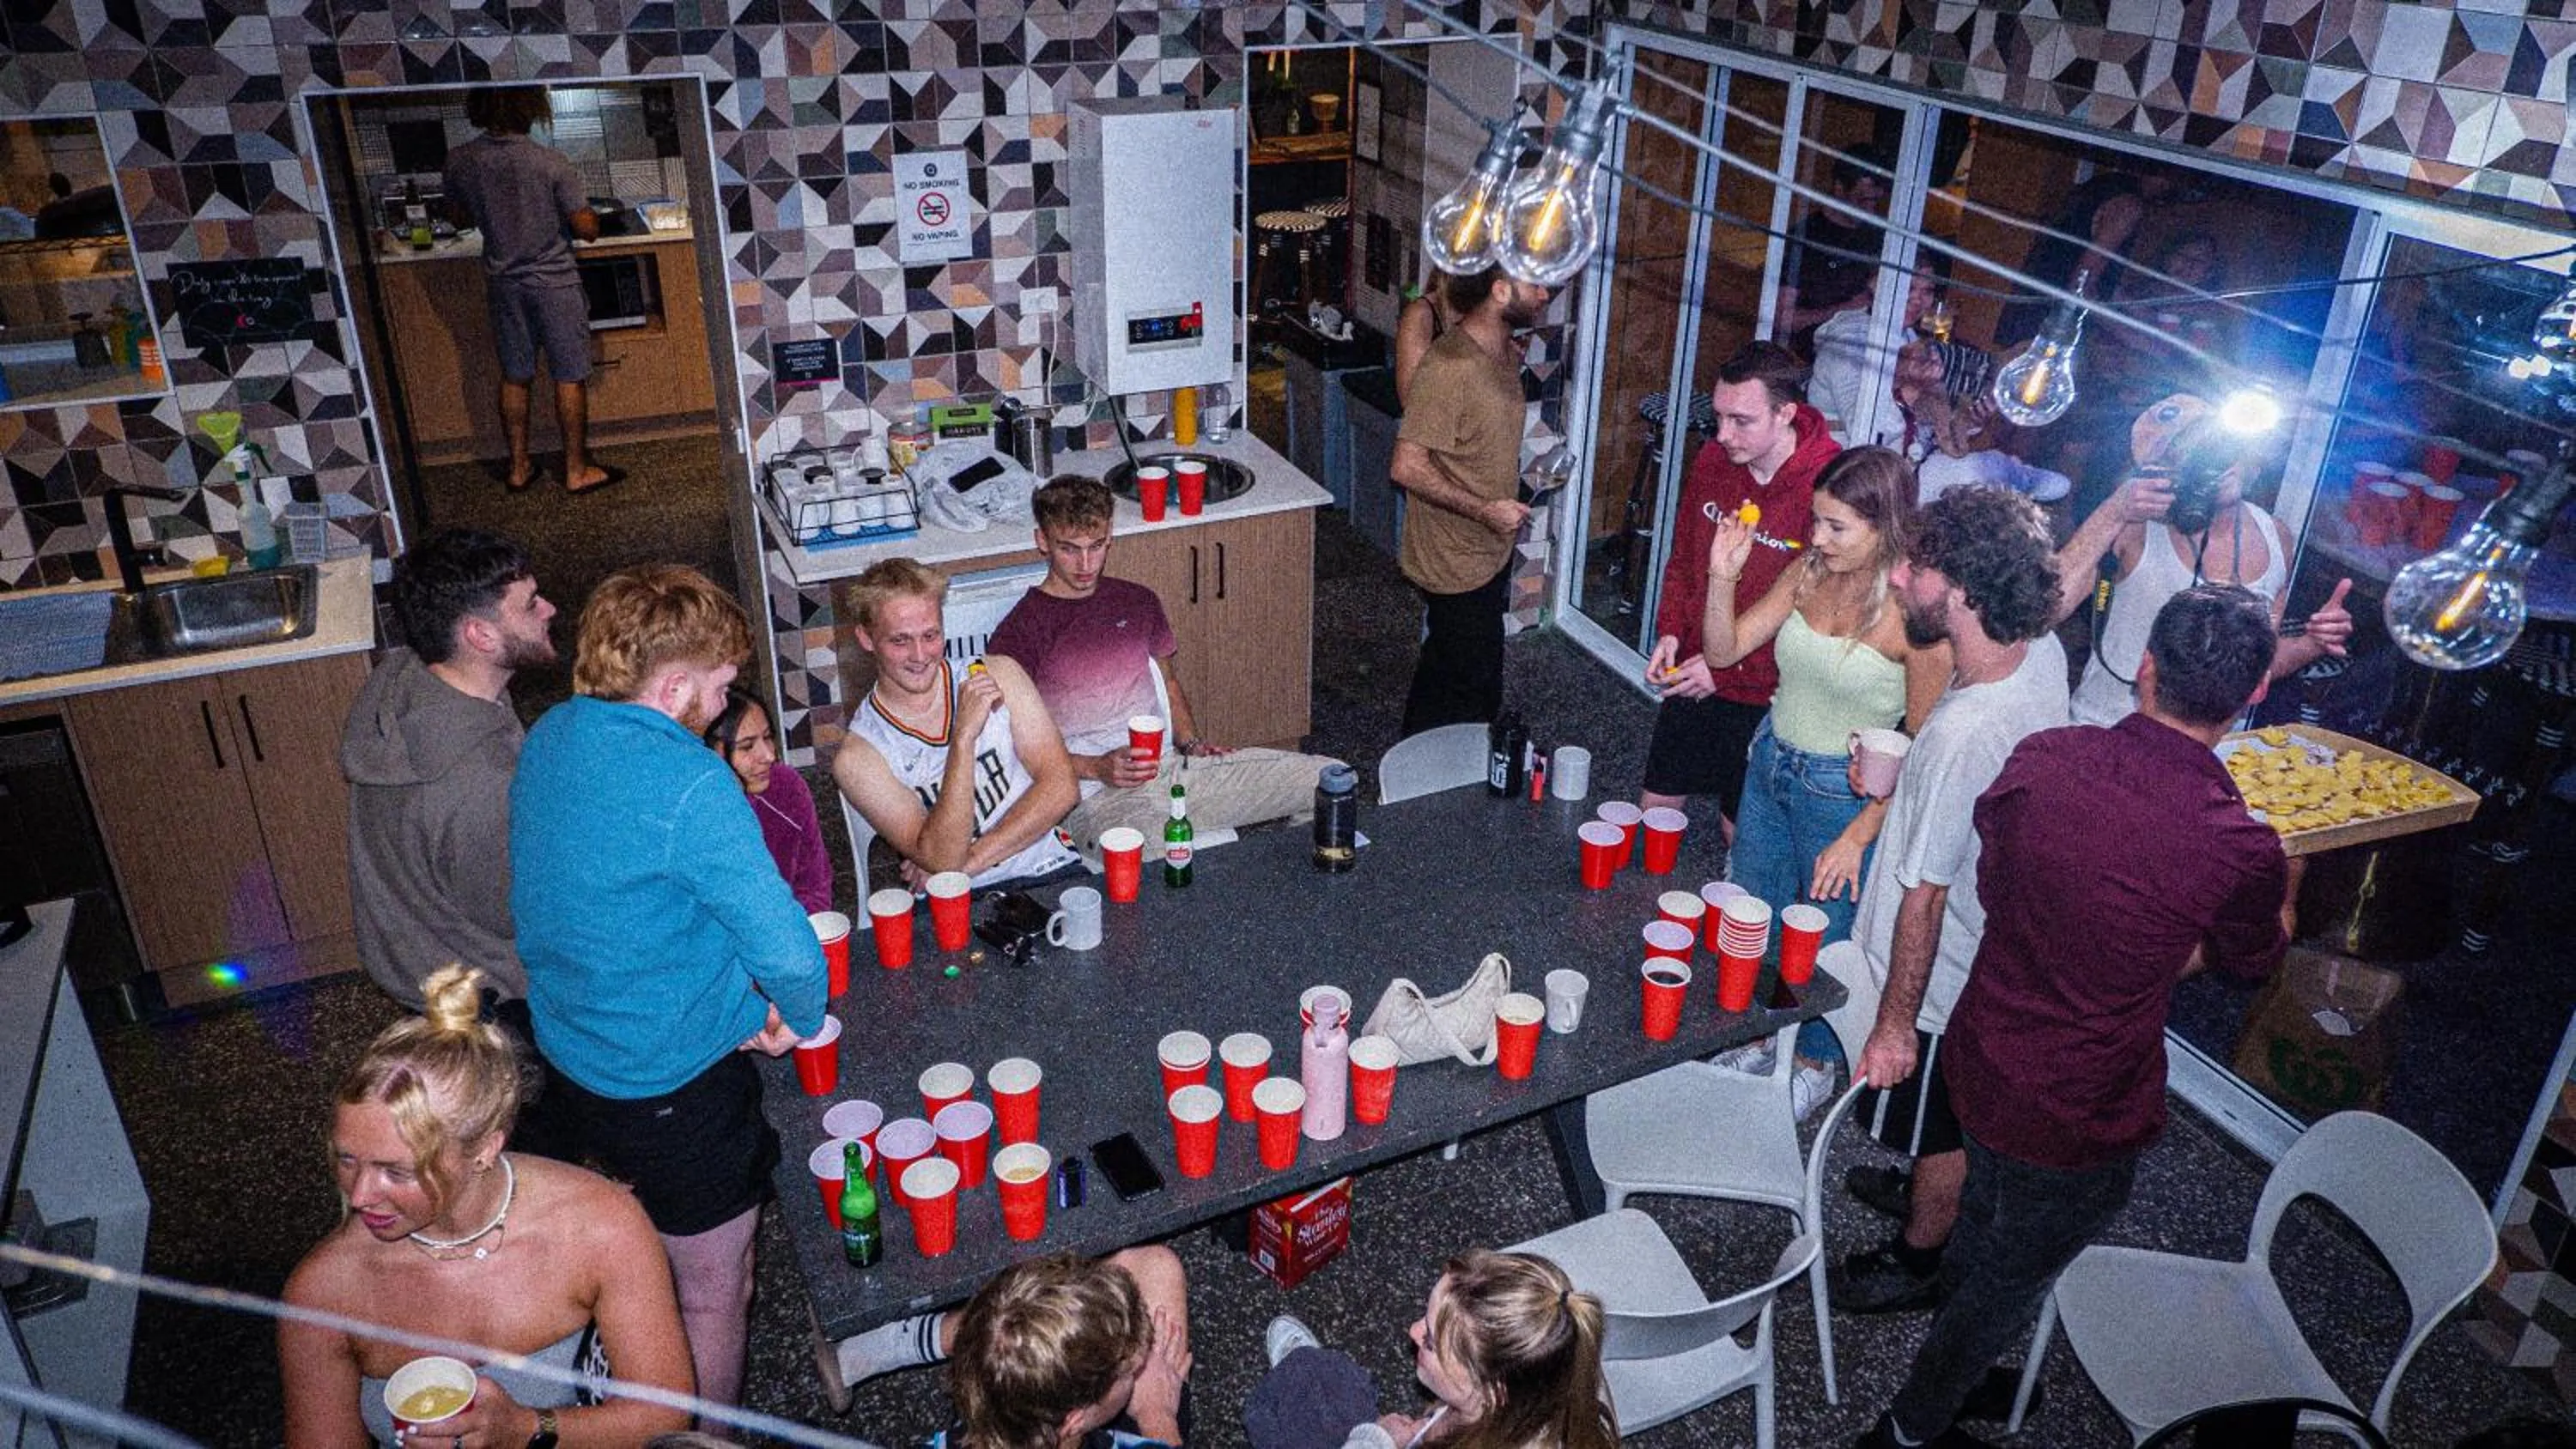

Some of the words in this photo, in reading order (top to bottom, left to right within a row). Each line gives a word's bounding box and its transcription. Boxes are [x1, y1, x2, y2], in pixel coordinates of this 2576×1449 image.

[903, 181, 917, 190] NO
[920, 179, 960, 190] SMOKING
[912, 233, 925, 241] NO
